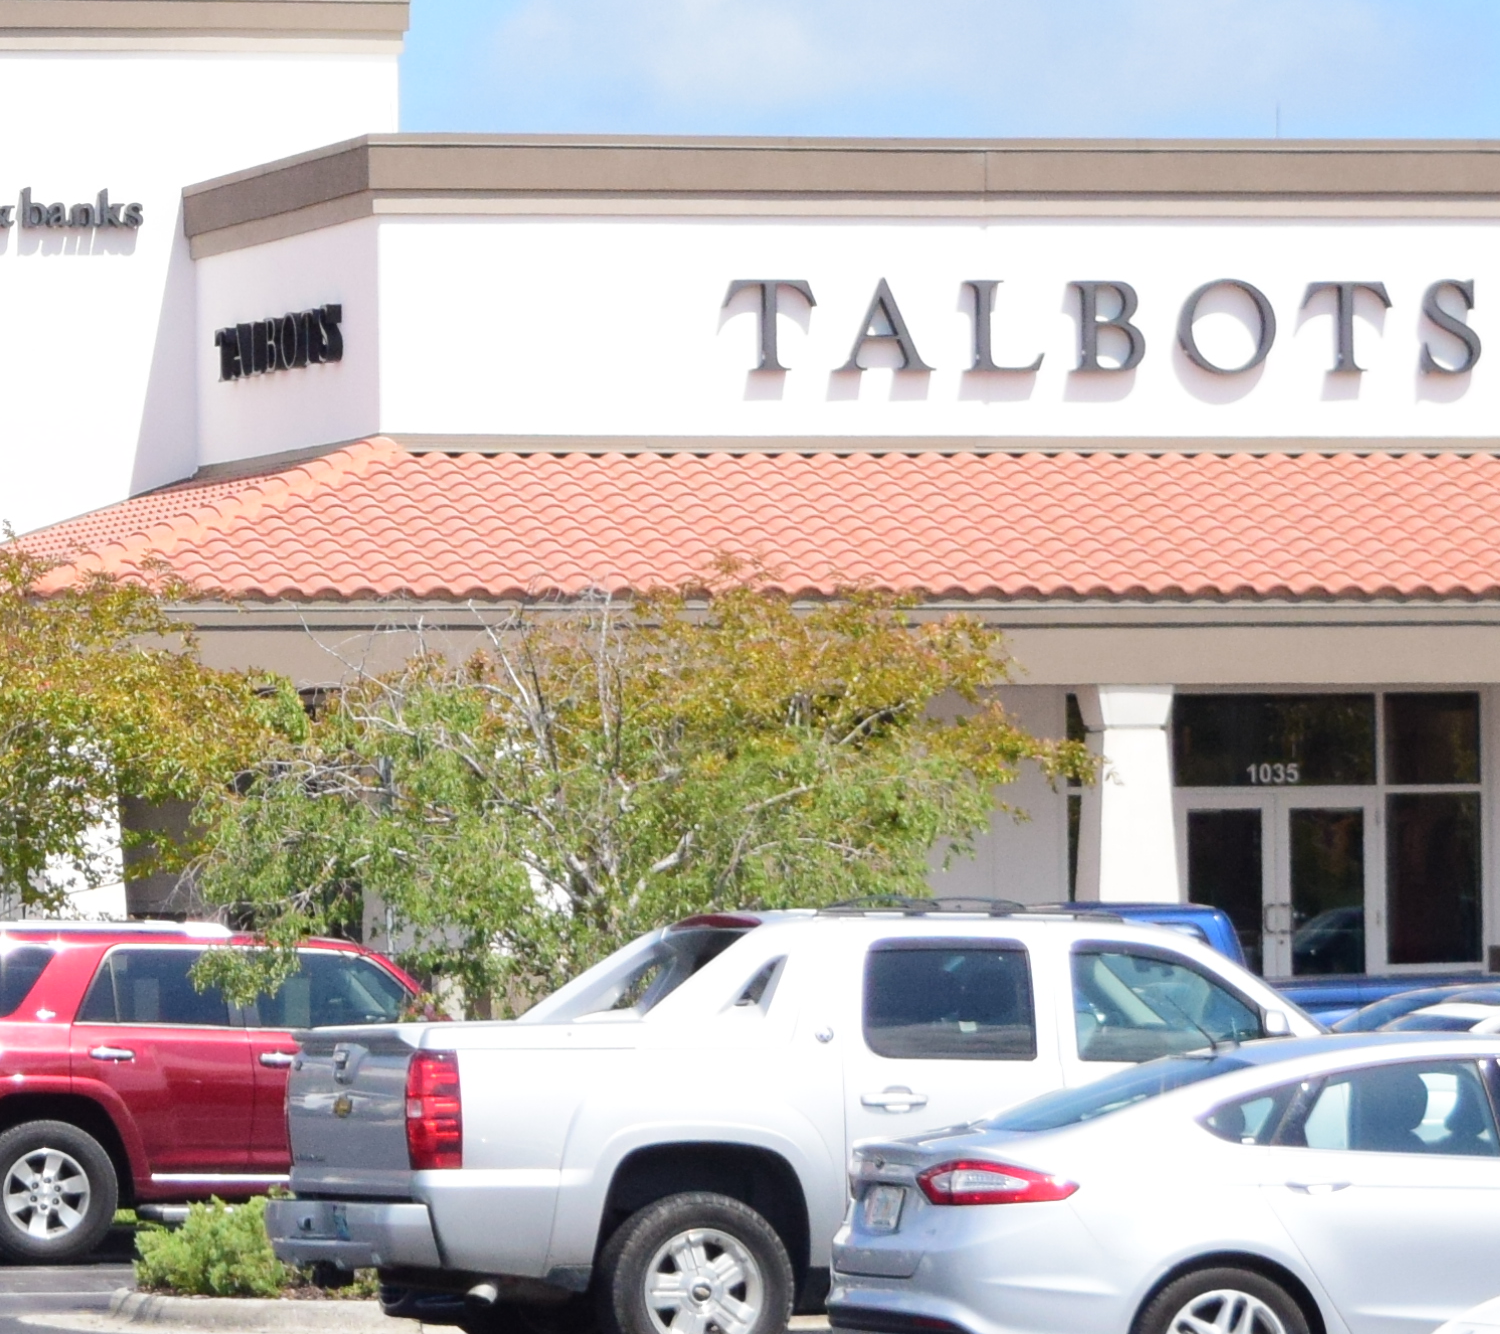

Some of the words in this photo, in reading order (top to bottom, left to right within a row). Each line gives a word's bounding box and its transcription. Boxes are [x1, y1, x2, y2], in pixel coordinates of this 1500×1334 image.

[21, 186, 144, 230] banks
[214, 303, 344, 383] TALBOTS
[720, 276, 1483, 376] TALBOTS
[1246, 762, 1299, 784] 1035
